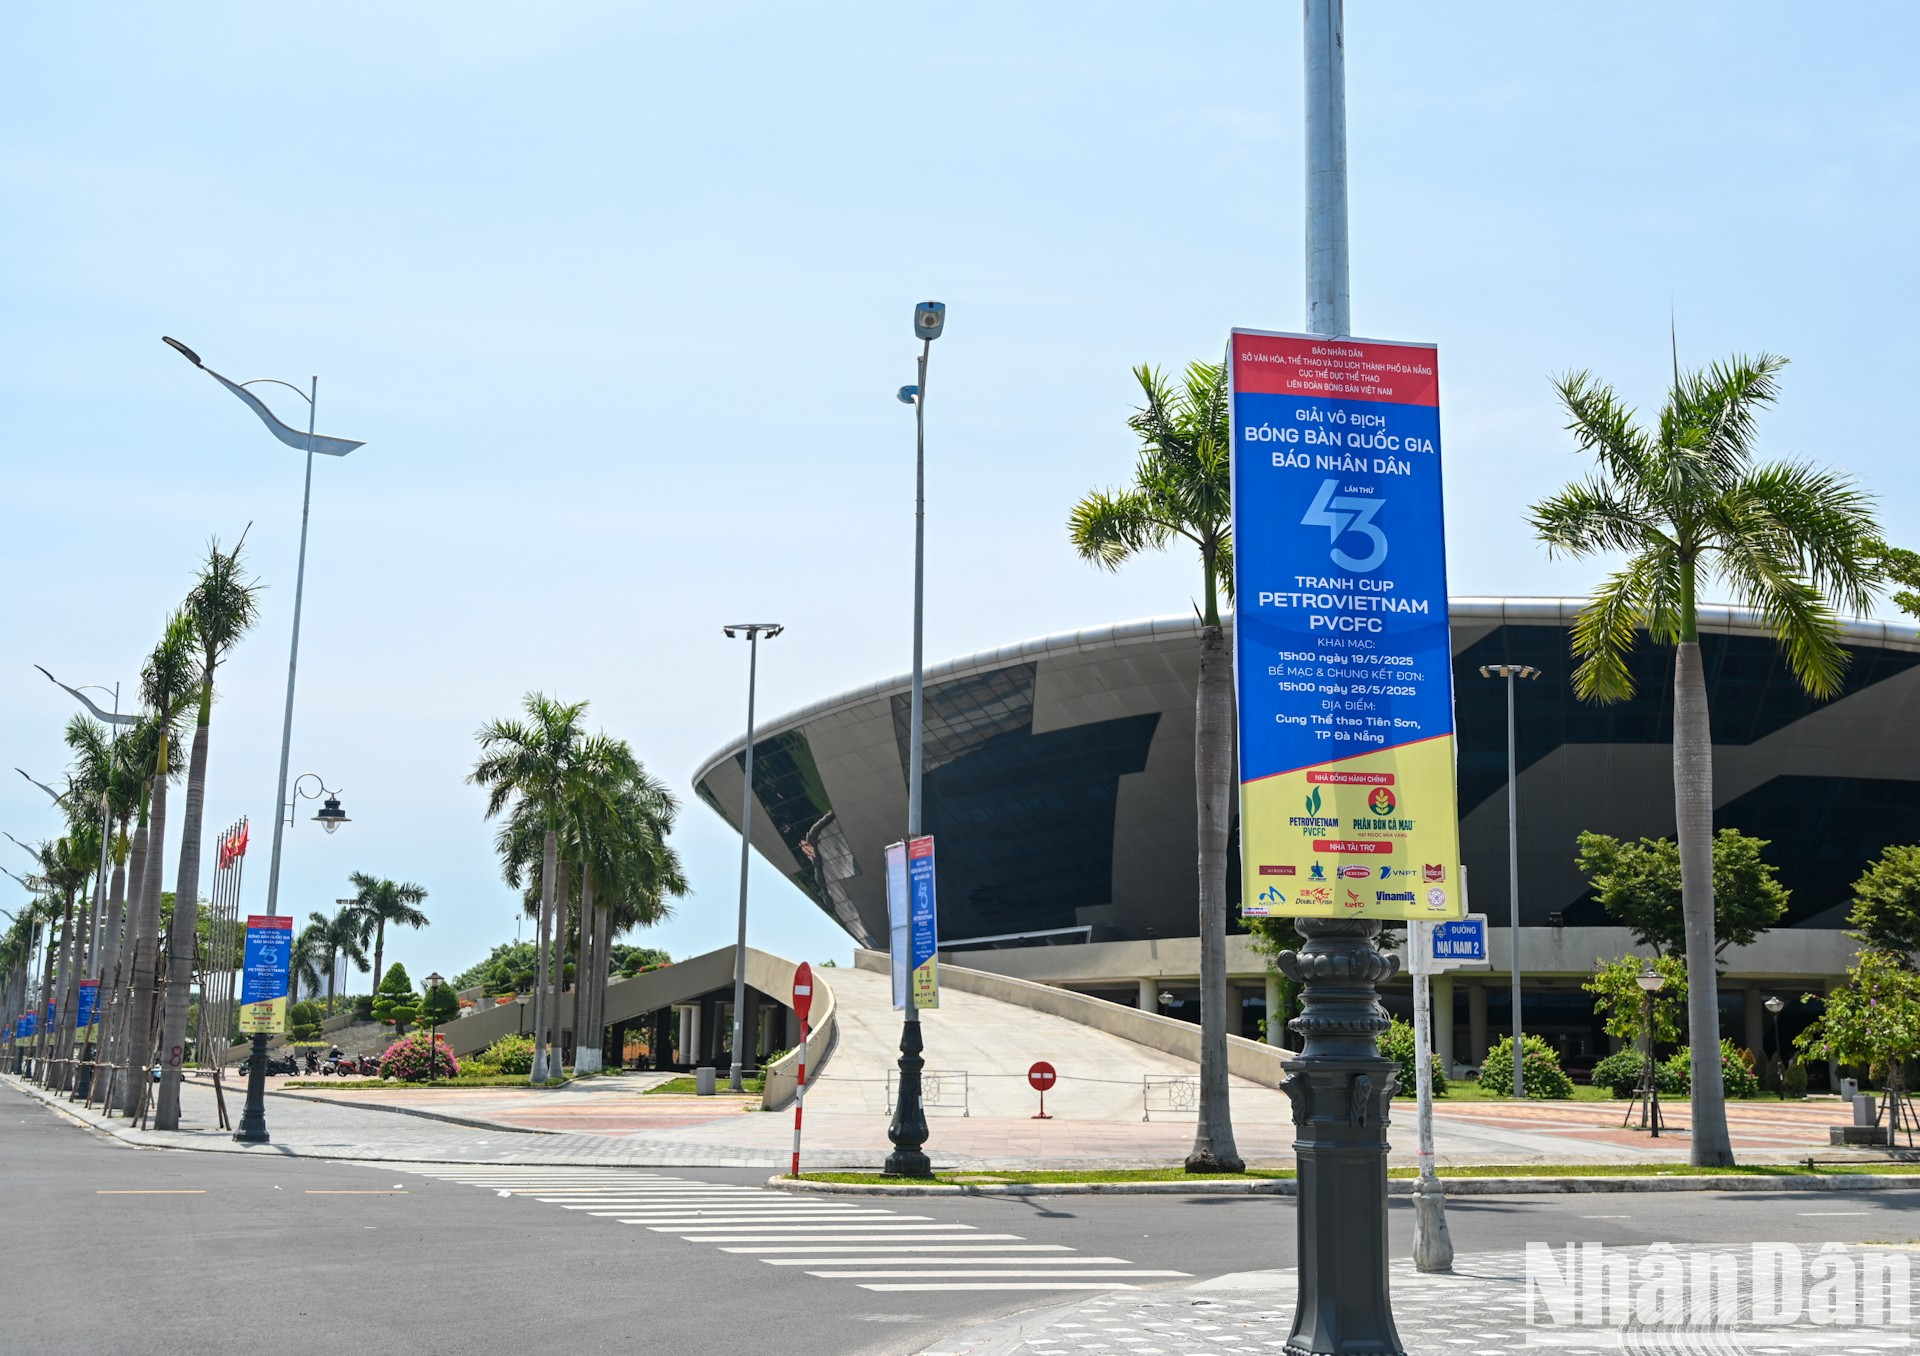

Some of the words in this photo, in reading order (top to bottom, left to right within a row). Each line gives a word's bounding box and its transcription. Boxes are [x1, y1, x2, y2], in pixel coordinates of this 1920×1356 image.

[1312, 346, 1327, 355] BÁO
[1328, 347, 1347, 356] NHÂN
[1349, 349, 1363, 357] DÂN
[1242, 352, 1253, 361] SỞ
[1254, 353, 1268, 362] VĂN
[1270, 354, 1287, 364] HÓA,
[1288, 355, 1302, 365] THỂ
[1303, 357, 1322, 367] THAO
[1323, 359, 1332, 367] VÀ
[1345, 361, 1360, 370] LỊCH
[1362, 361, 1385, 371] THÀNH
[1387, 363, 1401, 373] PHỐ
[1402, 364, 1412, 373] ĐÀ
[1413, 365, 1432, 375] NẴNG
[1299, 369, 1313, 378] CỤC
[1315, 368, 1328, 379] THỂ
[1330, 371, 1344, 380] DỤC
[1346, 371, 1359, 381] THỂ
[1361, 374, 1380, 383] THAO
[1287, 379, 1302, 388] LIÊN
[1303, 380, 1322, 390] ĐOÀN
[1324, 381, 1343, 391] BÓNG
[1345, 383, 1359, 393] BÀN
[1361, 385, 1376, 395] VIỆT
[1377, 387, 1392, 395] NAM
[1296, 407, 1323, 423] GIẢI
[1327, 409, 1346, 425] VÔ
[1350, 413, 1385, 429] ĐỊCH
[1245, 422, 1299, 443] BÓNG
[1304, 425, 1342, 447] BÀN
[1347, 428, 1400, 451] QUỐC
[1404, 437, 1434, 454] GIA
[1272, 449, 1311, 469] BÁO
[1316, 453, 1368, 473] NHÂN
[1373, 456, 1411, 476] DÂN
[1344, 484, 1358, 493] LẦN
[1360, 486, 1374, 494] THỨ
[1300, 478, 1388, 573] 43
[1294, 575, 1354, 590] TRANH
[1359, 579, 1394, 592] CUP
[1259, 591, 1429, 615] PETROVIETNAM
[1309, 615, 1383, 633] PVCFC
[1317, 637, 1344, 648] KHAI
[1348, 639, 1376, 650] MẠC:
[1278, 651, 1316, 662] 15h00
[1319, 653, 1348, 664] ngày
[1351, 654, 1414, 666] 19/5/2025
[1268, 663, 1284, 676] BẾ
[1287, 666, 1313, 678] MẠC
[1316, 667, 1324, 677] &
[1327, 668, 1369, 679] CHUNG
[1371, 666, 1393, 680] KẾT
[1396, 671, 1425, 682] ĐƠN:
[1278, 681, 1316, 692] 15h00
[1319, 683, 1348, 695] ngày
[1351, 684, 1416, 696] 26/5/2025
[1321, 699, 1341, 711] ĐỊA
[1344, 697, 1376, 711] ĐIỂM:
[1275, 713, 1307, 725] Cung
[1310, 713, 1333, 725] Thể
[1336, 716, 1363, 726] thao
[1366, 716, 1391, 727] Tiên
[1394, 718, 1421, 730] Sơn,
[1315, 730, 1331, 740] TP
[1334, 730, 1350, 741] Đà
[1354, 730, 1385, 744] Nẵng
[1330, 773, 1347, 782] ĐỒNG
[1349, 774, 1366, 782] HÀNH
[1367, 775, 1387, 783] CHÍNH
[1289, 816, 1339, 827] PETROVIETNAM
[1353, 817, 1371, 830] PHÂN
[1373, 818, 1386, 830] BÓN
[1388, 818, 1397, 831] CÀ
[1399, 820, 1413, 831] MAU
[1303, 827, 1326, 837] PVCFC
[1347, 843, 1358, 851] TÀI
[1360, 844, 1376, 852] TRỢ
[1376, 891, 1416, 901] Vinamilk
[1451, 924, 1477, 934] ĐƯỜNG
[1453, 941, 1472, 954] NAM
[1473, 942, 1479, 955] 2
